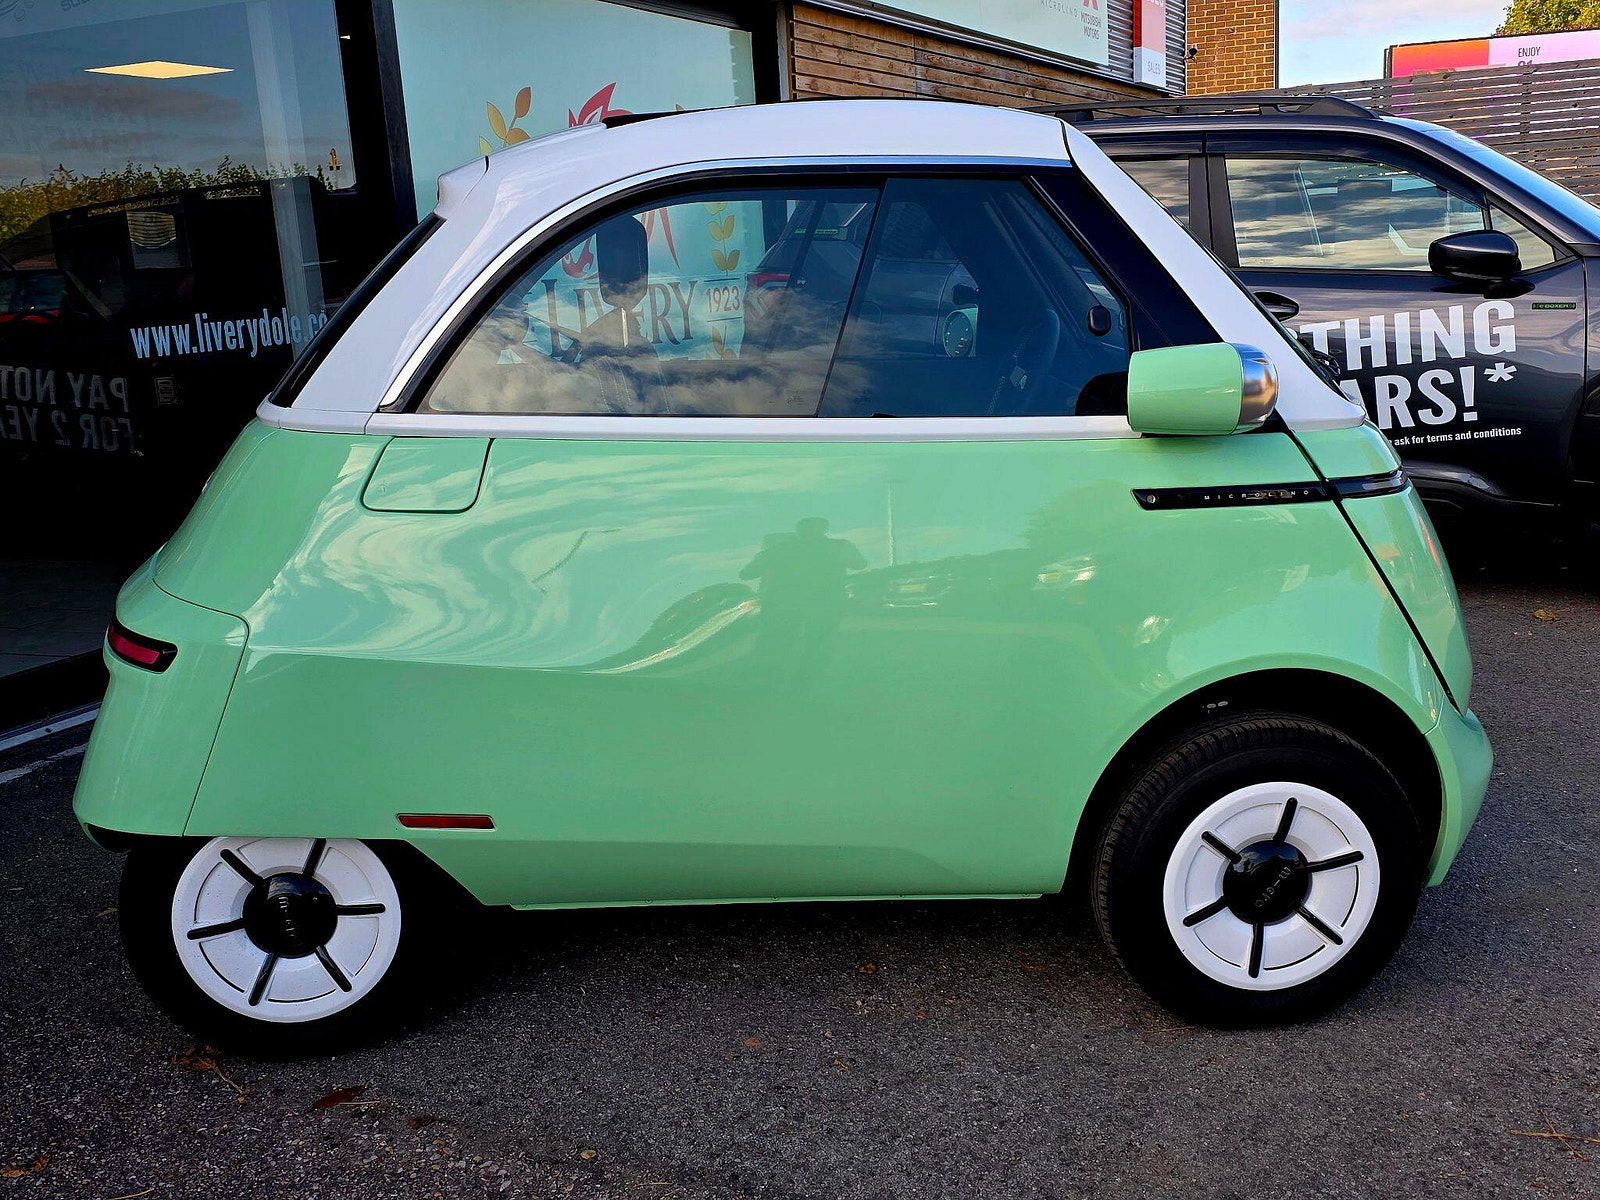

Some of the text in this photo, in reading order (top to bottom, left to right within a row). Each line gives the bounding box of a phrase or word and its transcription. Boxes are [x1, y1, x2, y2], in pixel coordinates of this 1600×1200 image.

[1083, 26, 1100, 40] MOTORS
[1518, 46, 1541, 57] ENJOY
[1147, 60, 1161, 75] SALES
[706, 285, 741, 313] 1923
[1394, 436, 1411, 447] ask
[1411, 435, 1425, 445] for
[1426, 433, 1453, 443] terms
[1455, 430, 1472, 441] and
[1473, 426, 1522, 439] conditions
[1204, 490, 1309, 500] MICROLINO
